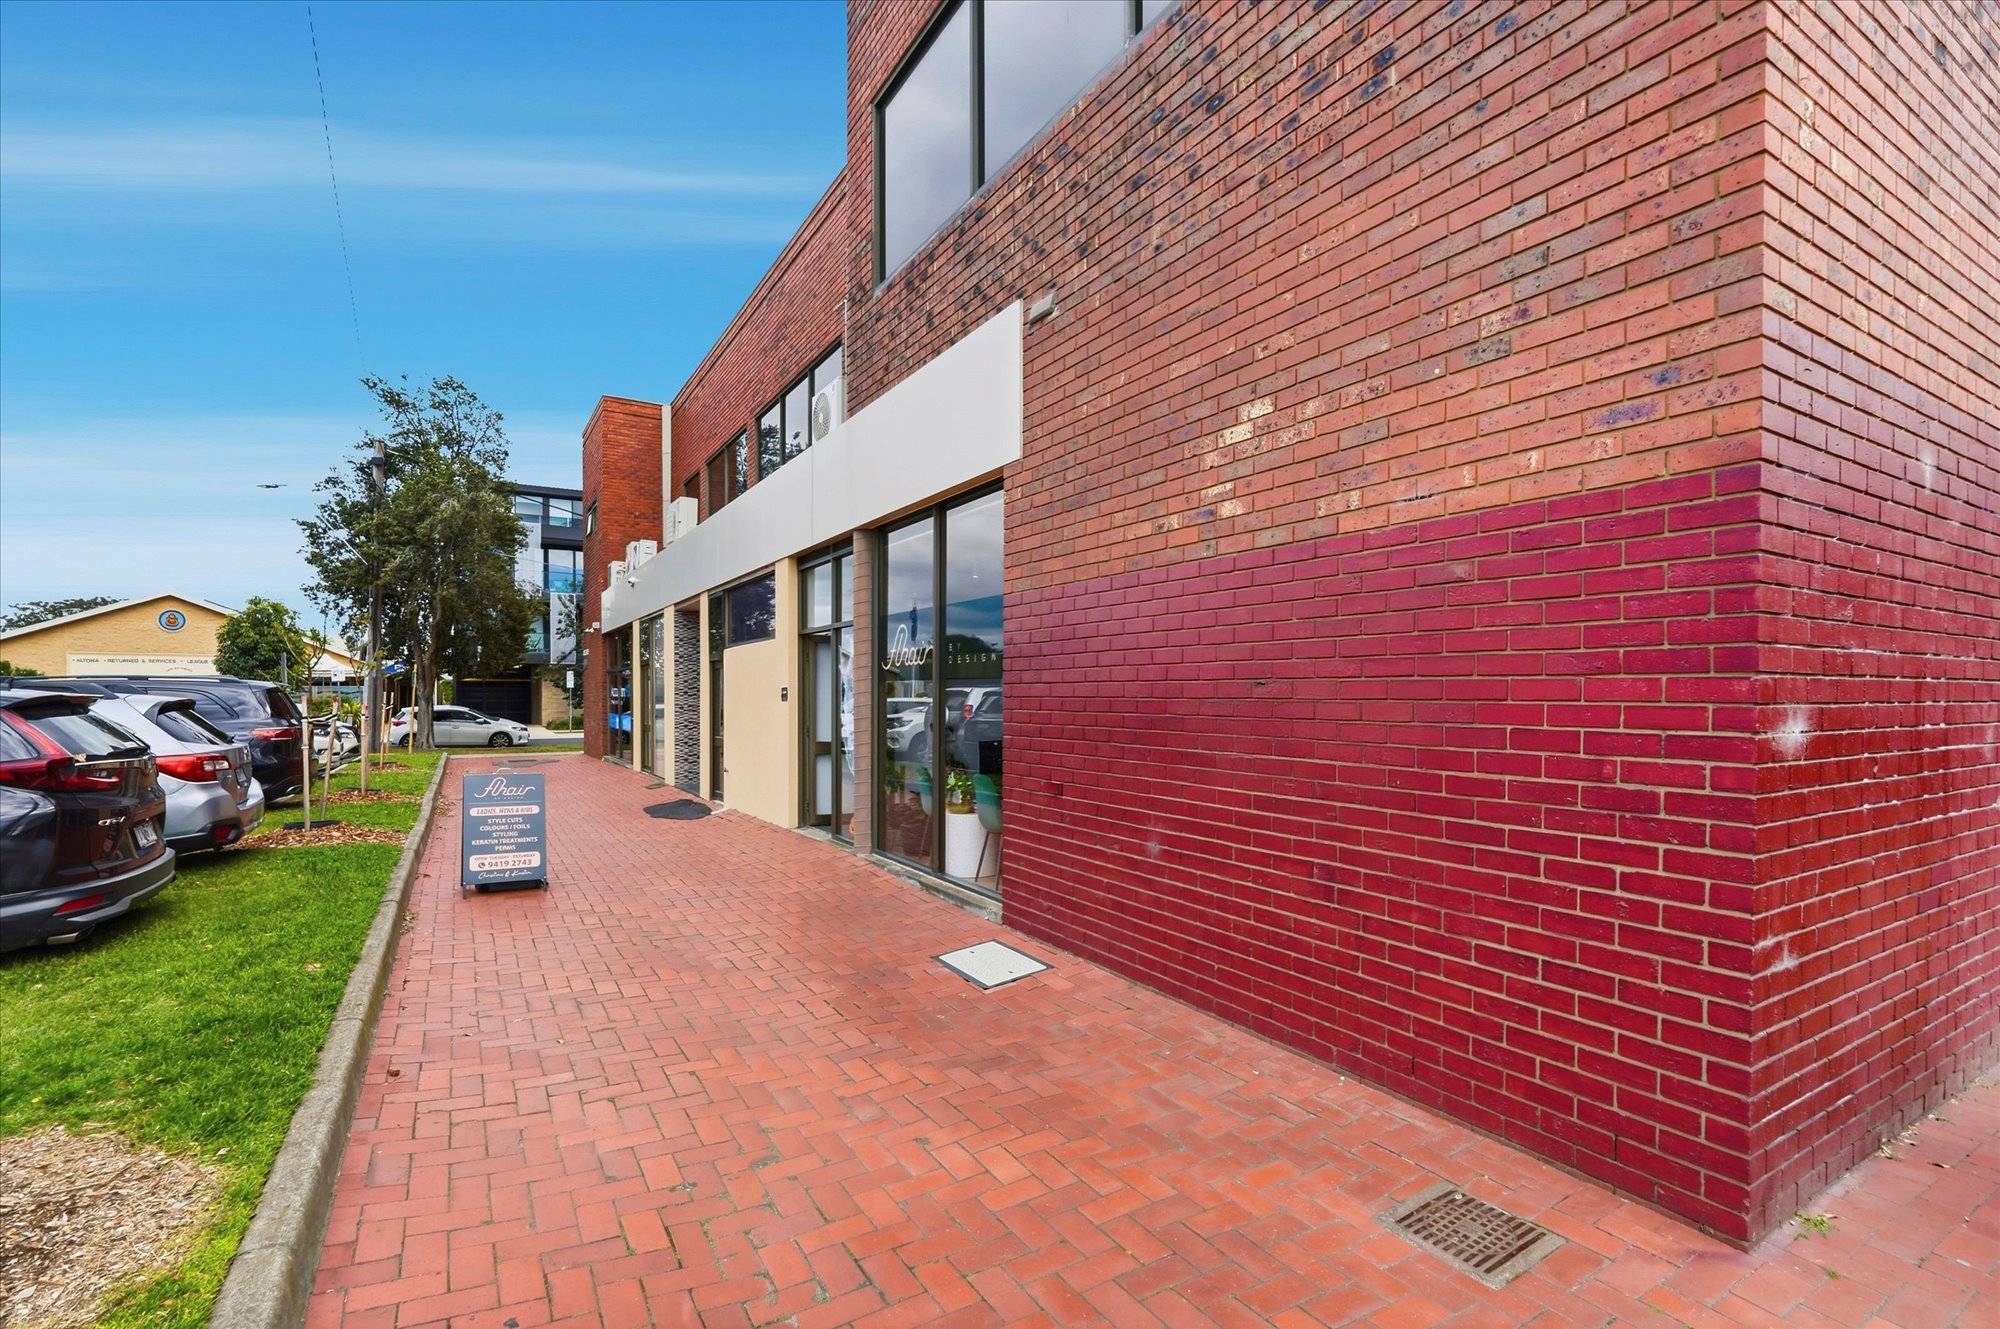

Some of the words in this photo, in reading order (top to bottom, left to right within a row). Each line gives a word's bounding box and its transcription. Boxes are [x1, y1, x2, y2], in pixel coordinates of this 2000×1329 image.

[948, 652, 997, 664] DESIGN
[471, 838, 498, 846] KERATIN
[499, 836, 538, 844] TREATMENTS
[488, 860, 510, 868] 9419
